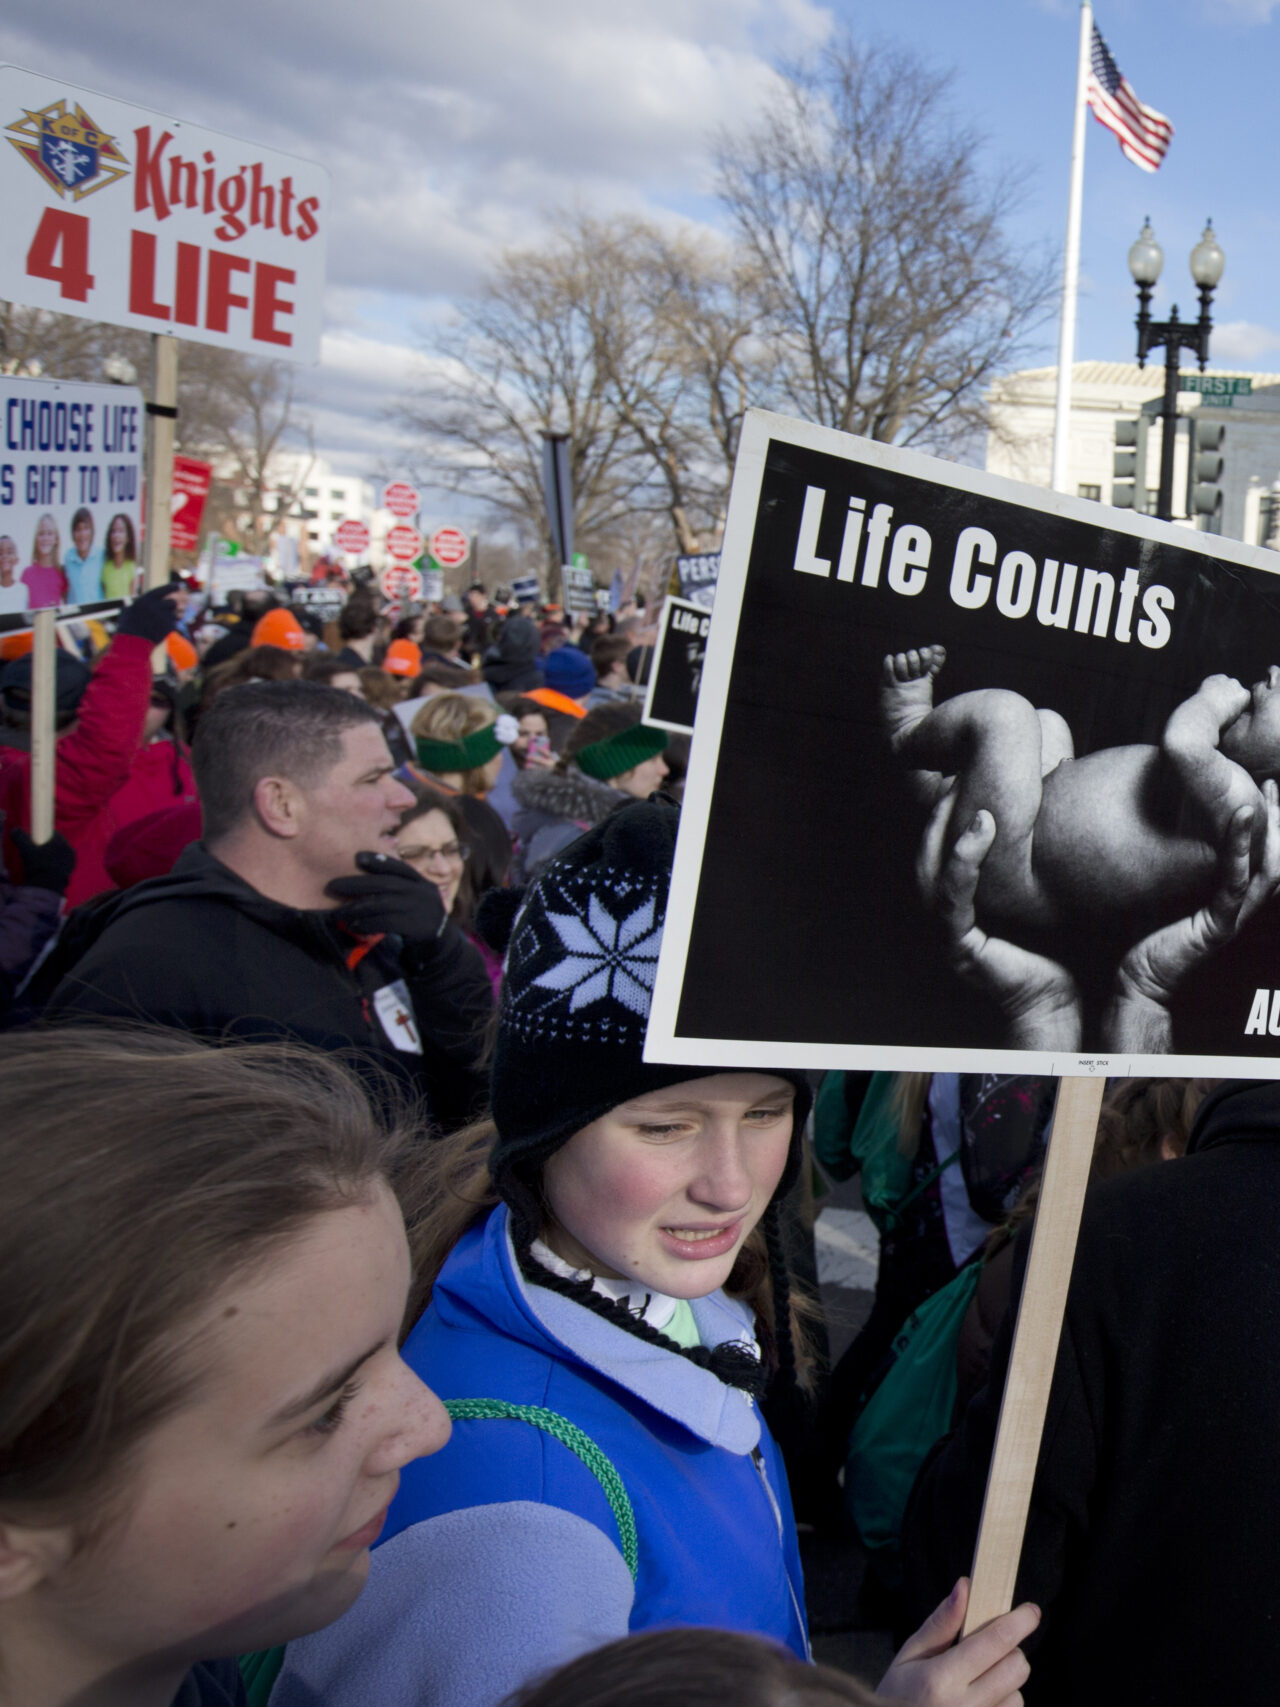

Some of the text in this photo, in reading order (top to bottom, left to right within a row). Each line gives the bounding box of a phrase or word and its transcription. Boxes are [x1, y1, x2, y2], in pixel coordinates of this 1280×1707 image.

[133, 125, 319, 242] Knights
[26, 206, 297, 347] 4 LIFE
[7, 398, 138, 453] CHOOSE LIFE
[1185, 375, 1235, 394] FIRST
[26, 465, 70, 505] GIFT
[79, 465, 100, 504] TO
[107, 465, 137, 502] YOU
[793, 485, 1175, 649] Life Counts
